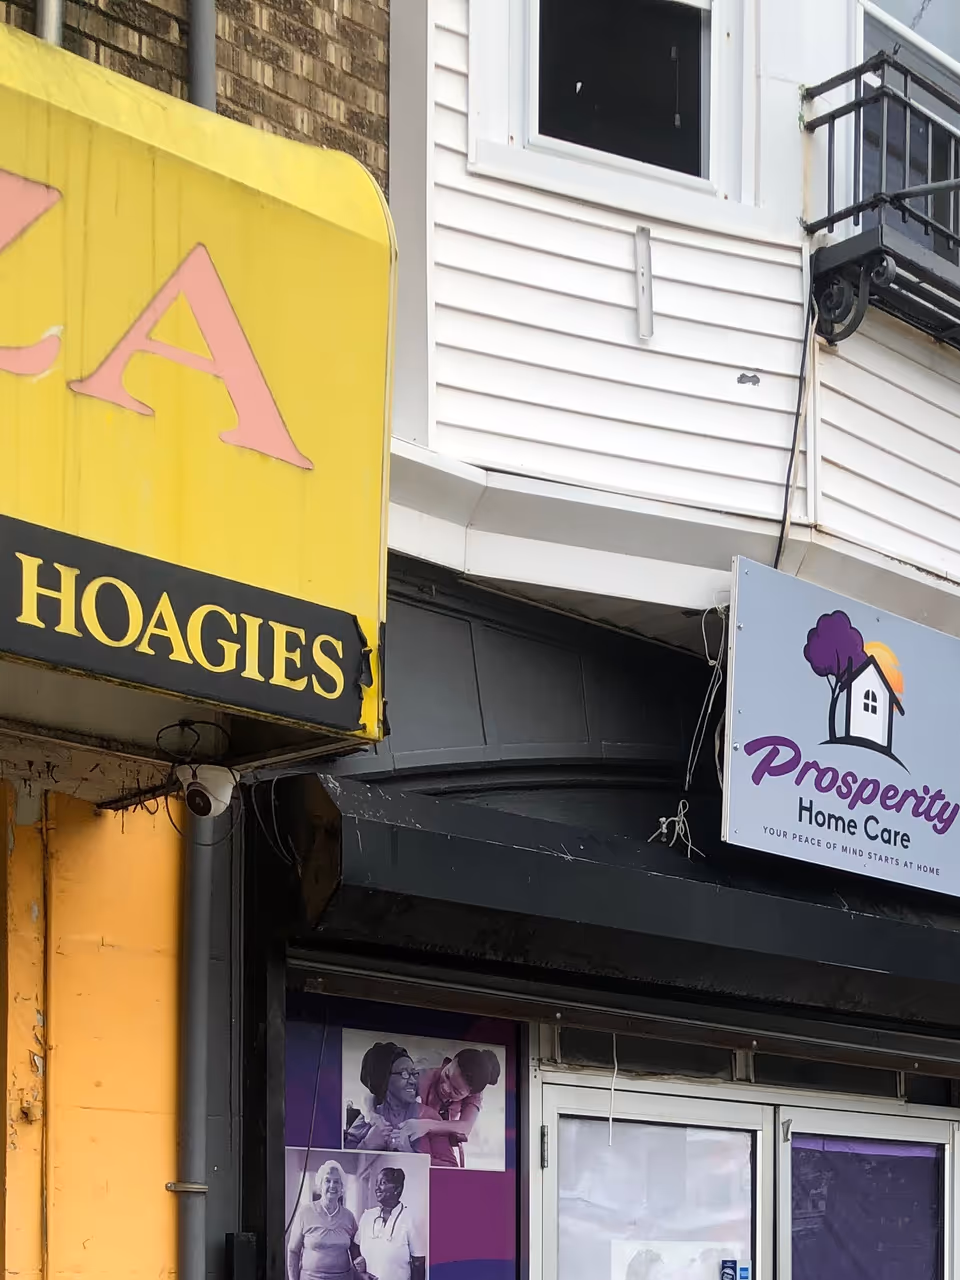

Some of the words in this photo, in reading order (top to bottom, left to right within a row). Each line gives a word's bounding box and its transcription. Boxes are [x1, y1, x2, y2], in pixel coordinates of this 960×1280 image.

[14, 552, 345, 700] HOAGIES
[743, 735, 960, 835] Prosperity
[798, 796, 858, 836] Home
[863, 814, 911, 850] Care
[762, 825, 788, 840] YOUR
[792, 832, 822, 848] PEACE
[825, 840, 838, 851] OF
[841, 844, 865, 858] MIND
[867, 850, 901, 866] STARTS
[903, 859, 914, 870] AT
[917, 862, 941, 876] HOME
